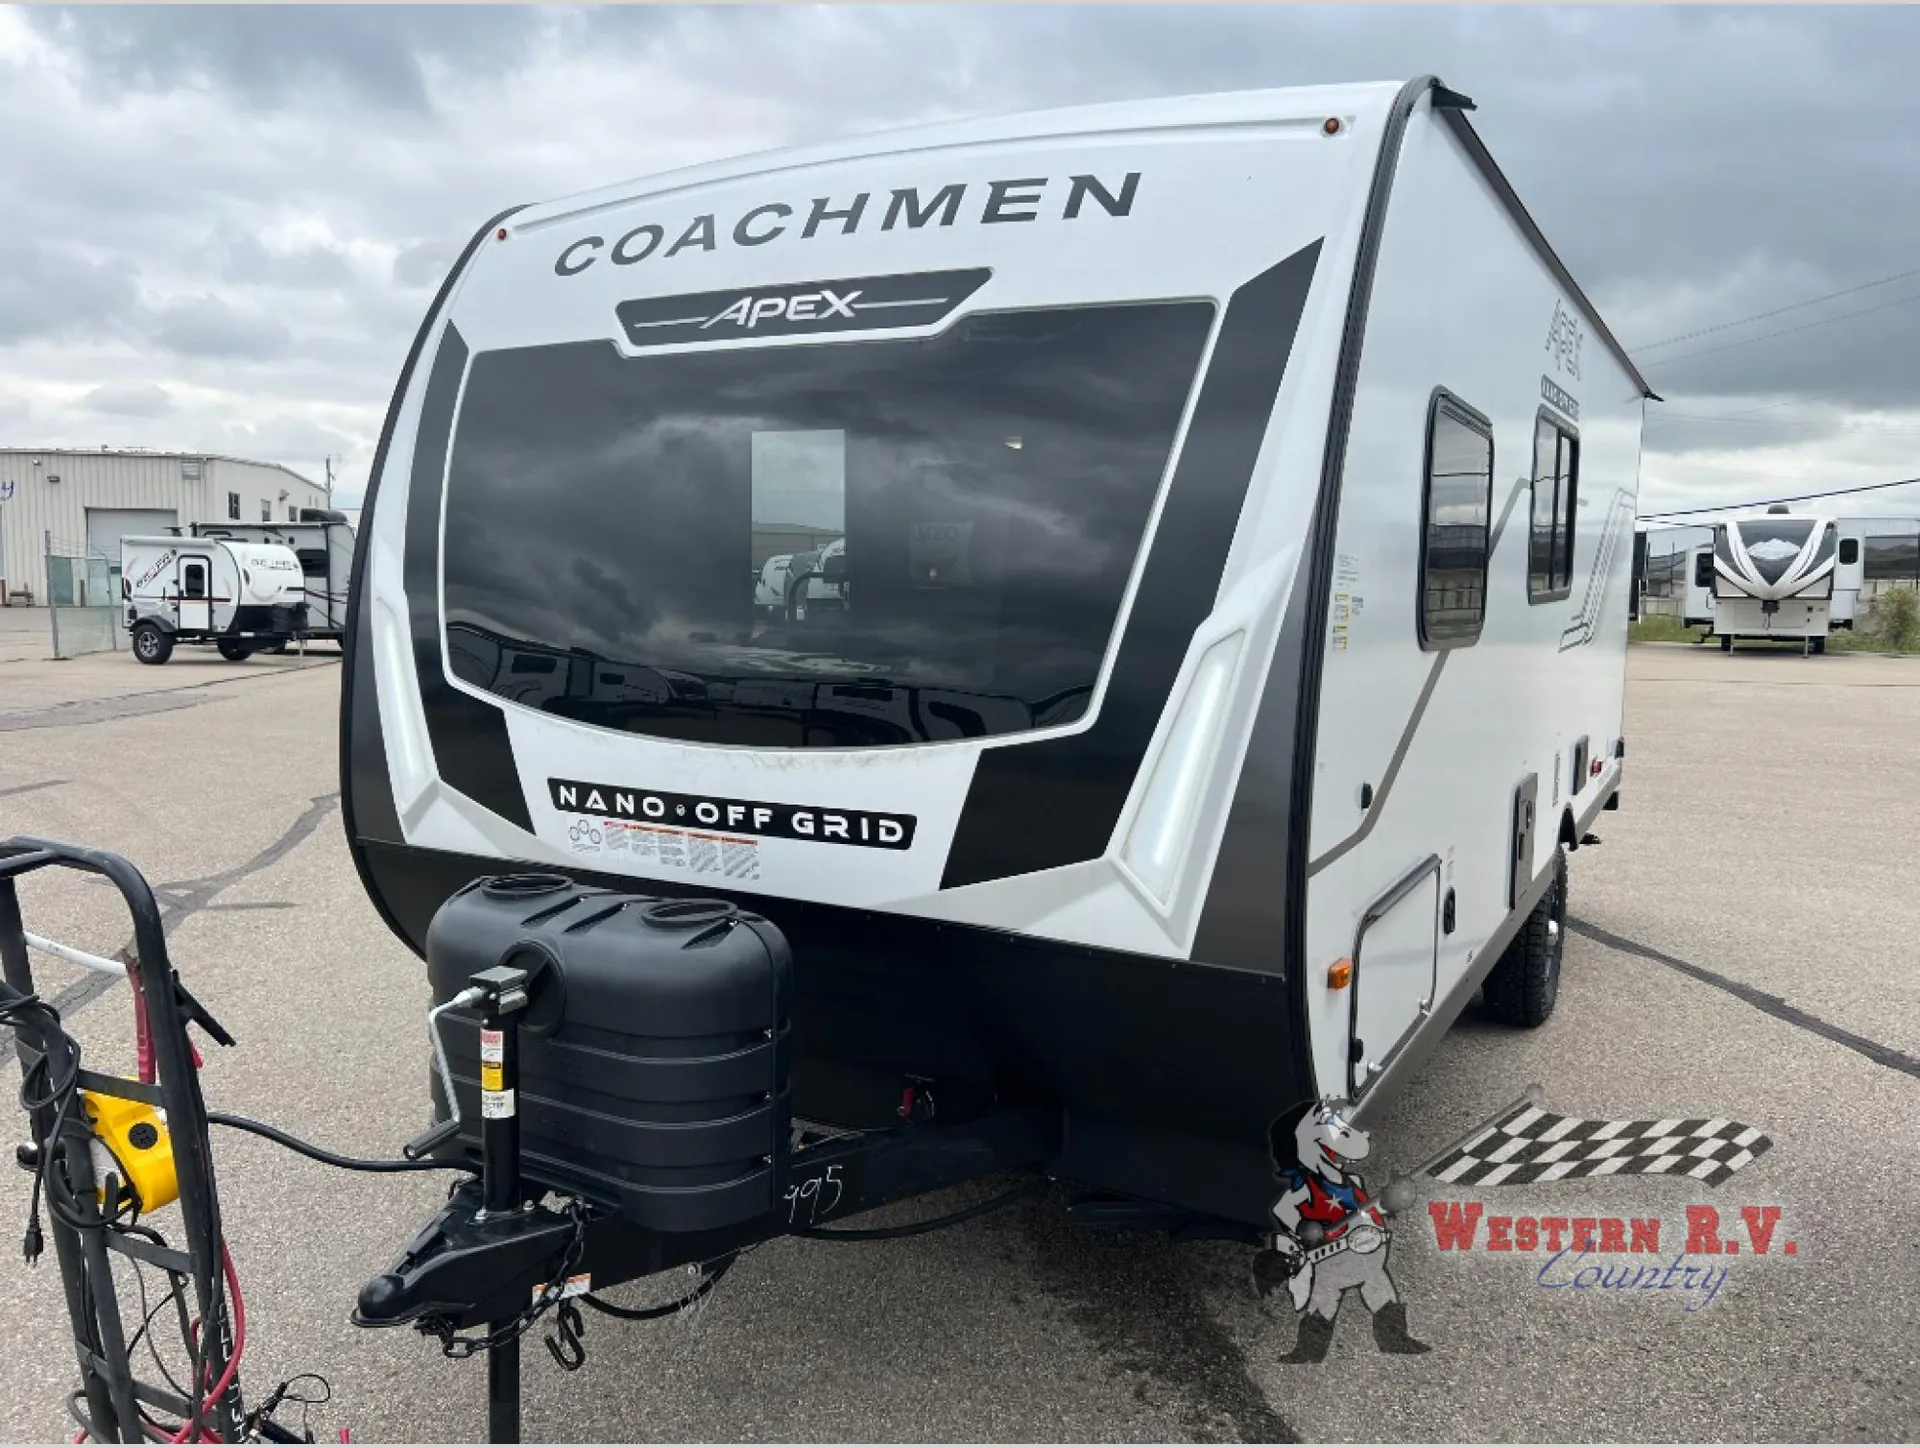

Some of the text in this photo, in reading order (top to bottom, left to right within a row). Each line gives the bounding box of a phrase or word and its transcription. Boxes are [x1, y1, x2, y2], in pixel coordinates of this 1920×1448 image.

[554, 172, 1141, 276] COACHMEN
[699, 289, 863, 329] APEX
[559, 785, 904, 844] NANO OFF GRID
